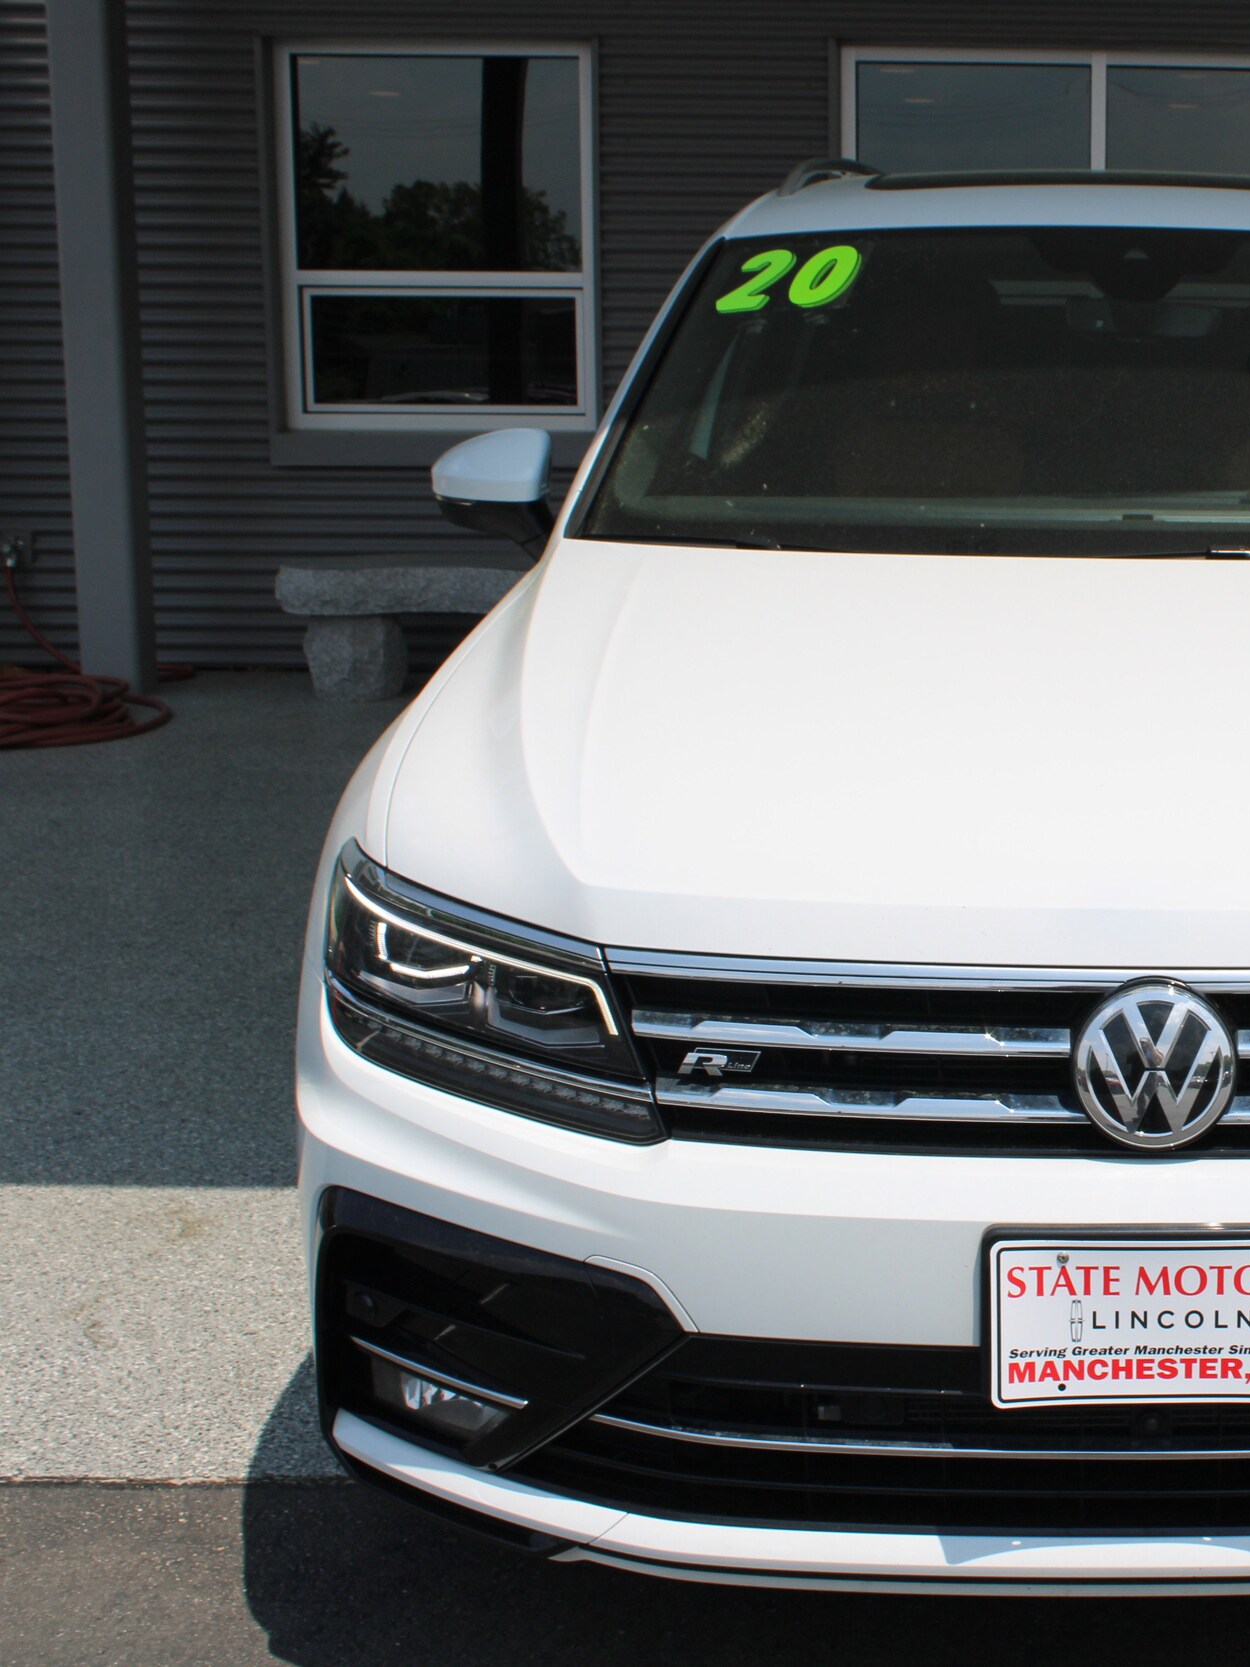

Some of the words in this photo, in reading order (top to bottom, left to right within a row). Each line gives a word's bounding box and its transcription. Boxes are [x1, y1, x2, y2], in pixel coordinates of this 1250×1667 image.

[715, 245, 862, 313] 20
[677, 1052, 728, 1076] R
[1007, 1265, 1121, 1298] STATE
[1009, 1347, 1067, 1359] Serving
[1071, 1345, 1130, 1356] Greater
[1134, 1345, 1224, 1356] Manchester
